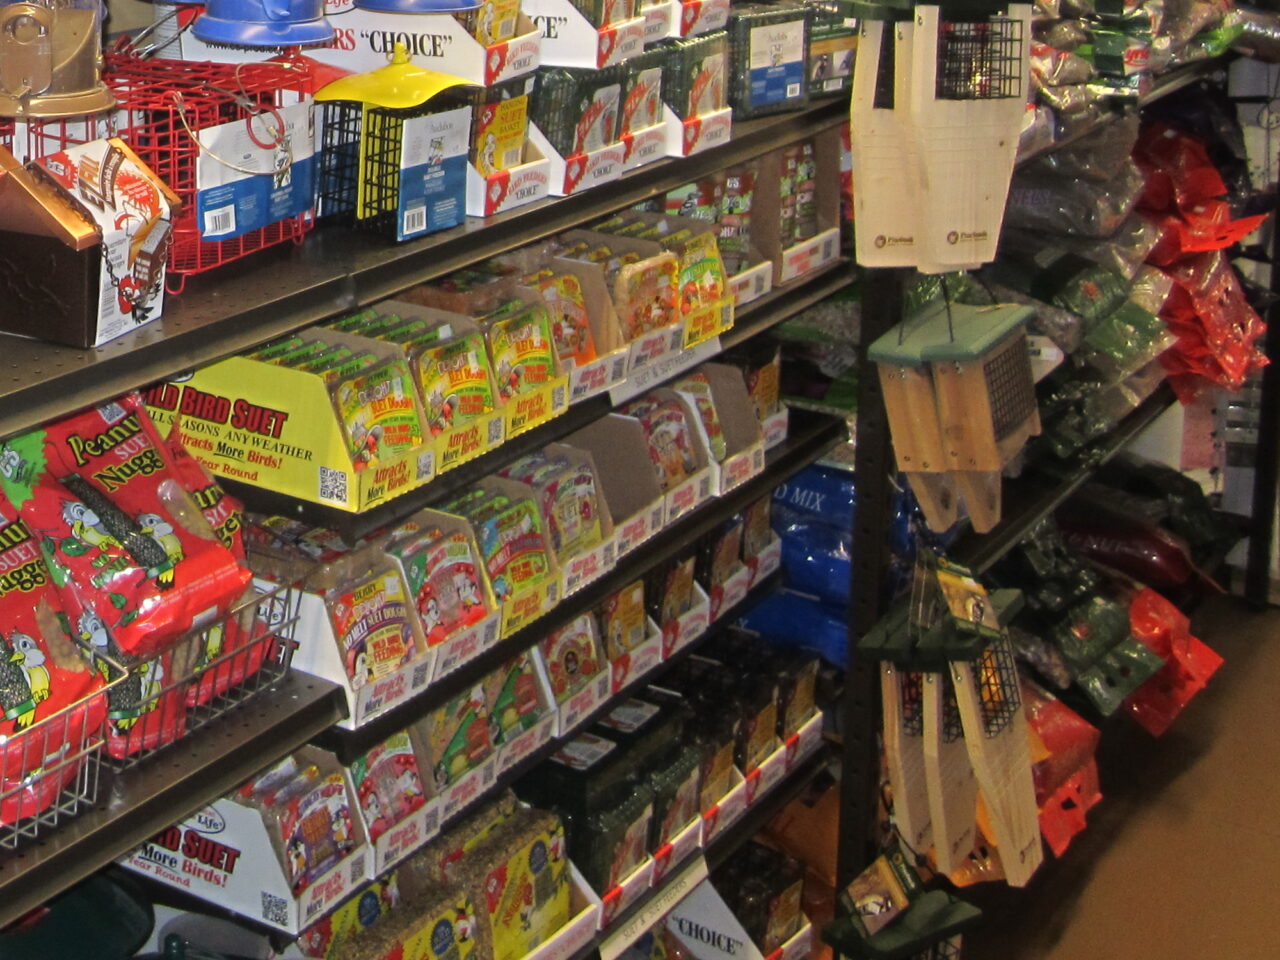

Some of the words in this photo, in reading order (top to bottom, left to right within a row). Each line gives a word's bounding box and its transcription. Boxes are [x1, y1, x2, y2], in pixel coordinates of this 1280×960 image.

[360, 29, 453, 58] “CHOICE”
[501, 108, 523, 122] SUET
[147, 383, 180, 412] ILD
[179, 385, 233, 426] BIRD
[231, 398, 290, 439] SUET
[68, 413, 142, 468] Peanu
[114, 433, 151, 461] SUE
[147, 410, 166, 424] ALL
[168, 416, 221, 438] SASONS
[225, 429, 250, 445] ANY
[252, 437, 314, 461] WEATHER
[448, 424, 479, 448] Attracts
[91, 447, 166, 492] Nugg
[216, 441, 245, 459] More
[247, 450, 284, 470] Birds!
[223, 465, 259, 481] Round
[374, 459, 408, 484] Attracts
[790, 487, 827, 512] MIX
[197, 814, 220, 830] Life
[140, 843, 178, 869] More
[181, 858, 229, 888] Birds!
[182, 829, 241, 874] SUET
[154, 865, 191, 888] Round
[672, 914, 744, 955] “CHOICE”
